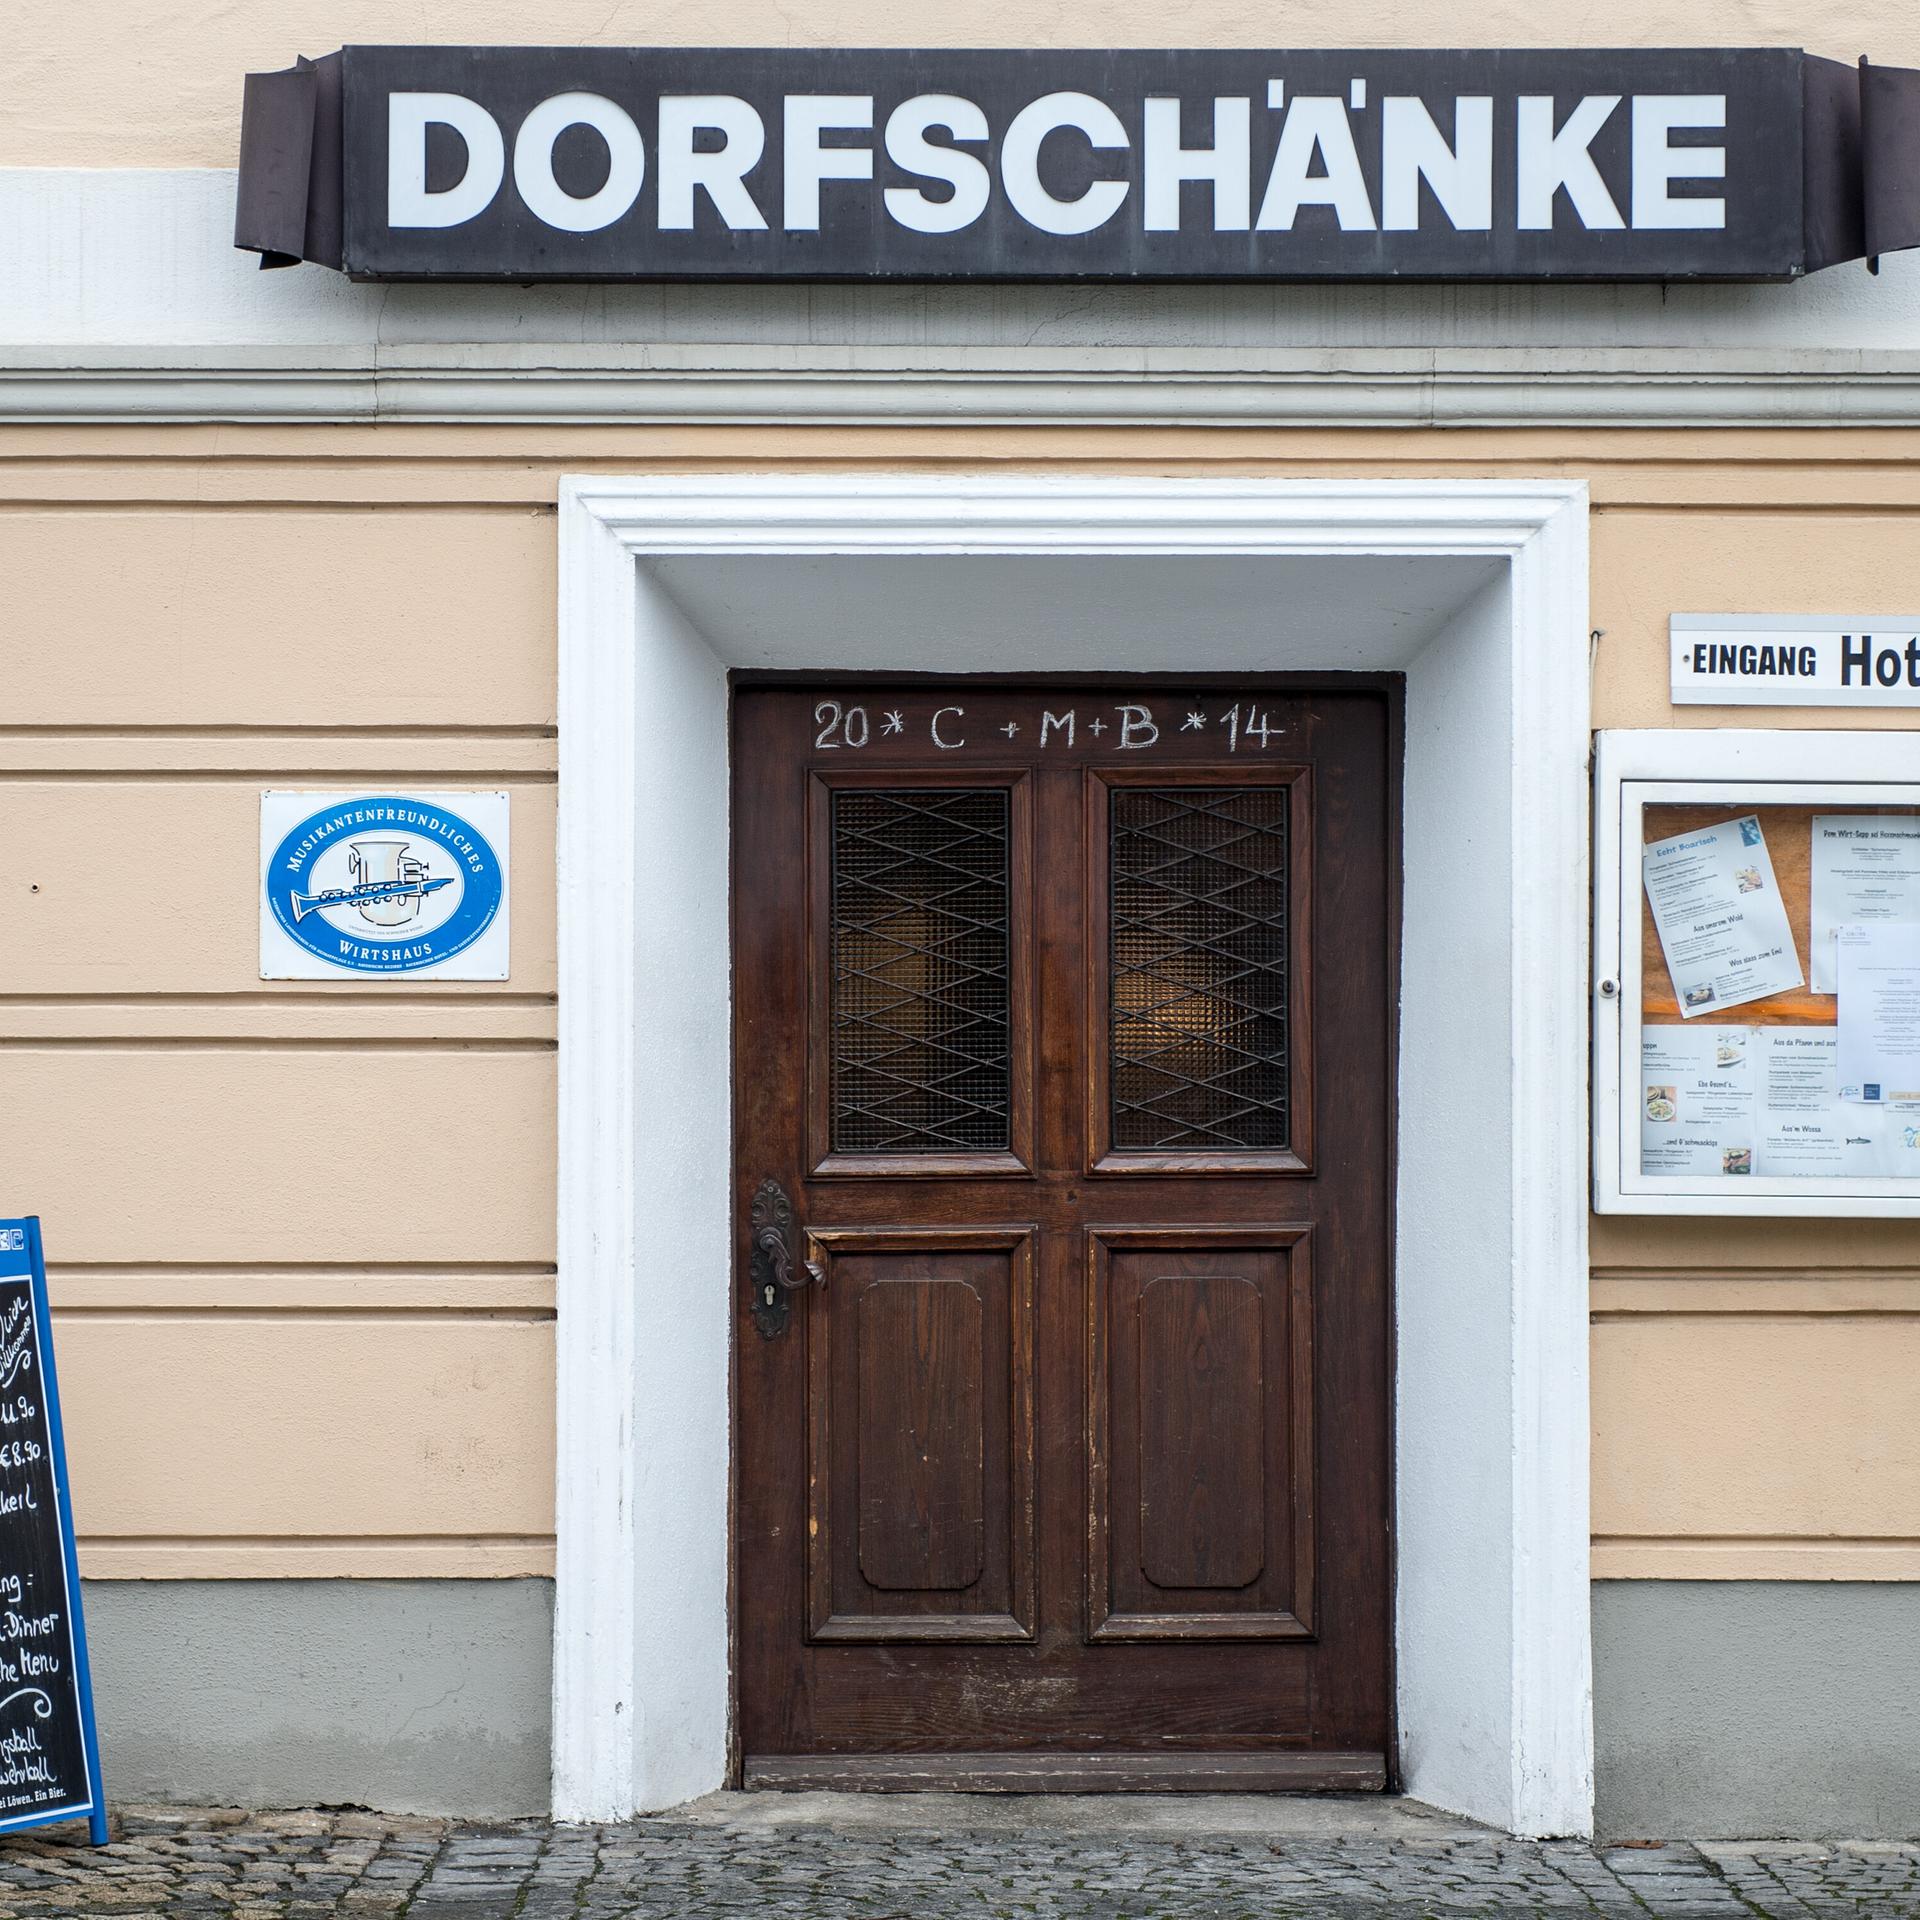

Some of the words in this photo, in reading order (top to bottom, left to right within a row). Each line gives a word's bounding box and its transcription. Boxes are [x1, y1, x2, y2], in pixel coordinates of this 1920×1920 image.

[387, 79, 1727, 235] DORFSCHÄNKE
[1693, 644, 1817, 676] EINGANG
[930, 706, 966, 749] C
[286, 808, 484, 873] MUSIKANTENFREUNDLICHES
[339, 939, 433, 961] WIRTSHAUS
[0, 1656, 19, 1683] he
[7, 1793, 34, 1807] Löwen.
[34, 1789, 48, 1802] Ein
[48, 1786, 67, 1799] Bier.
